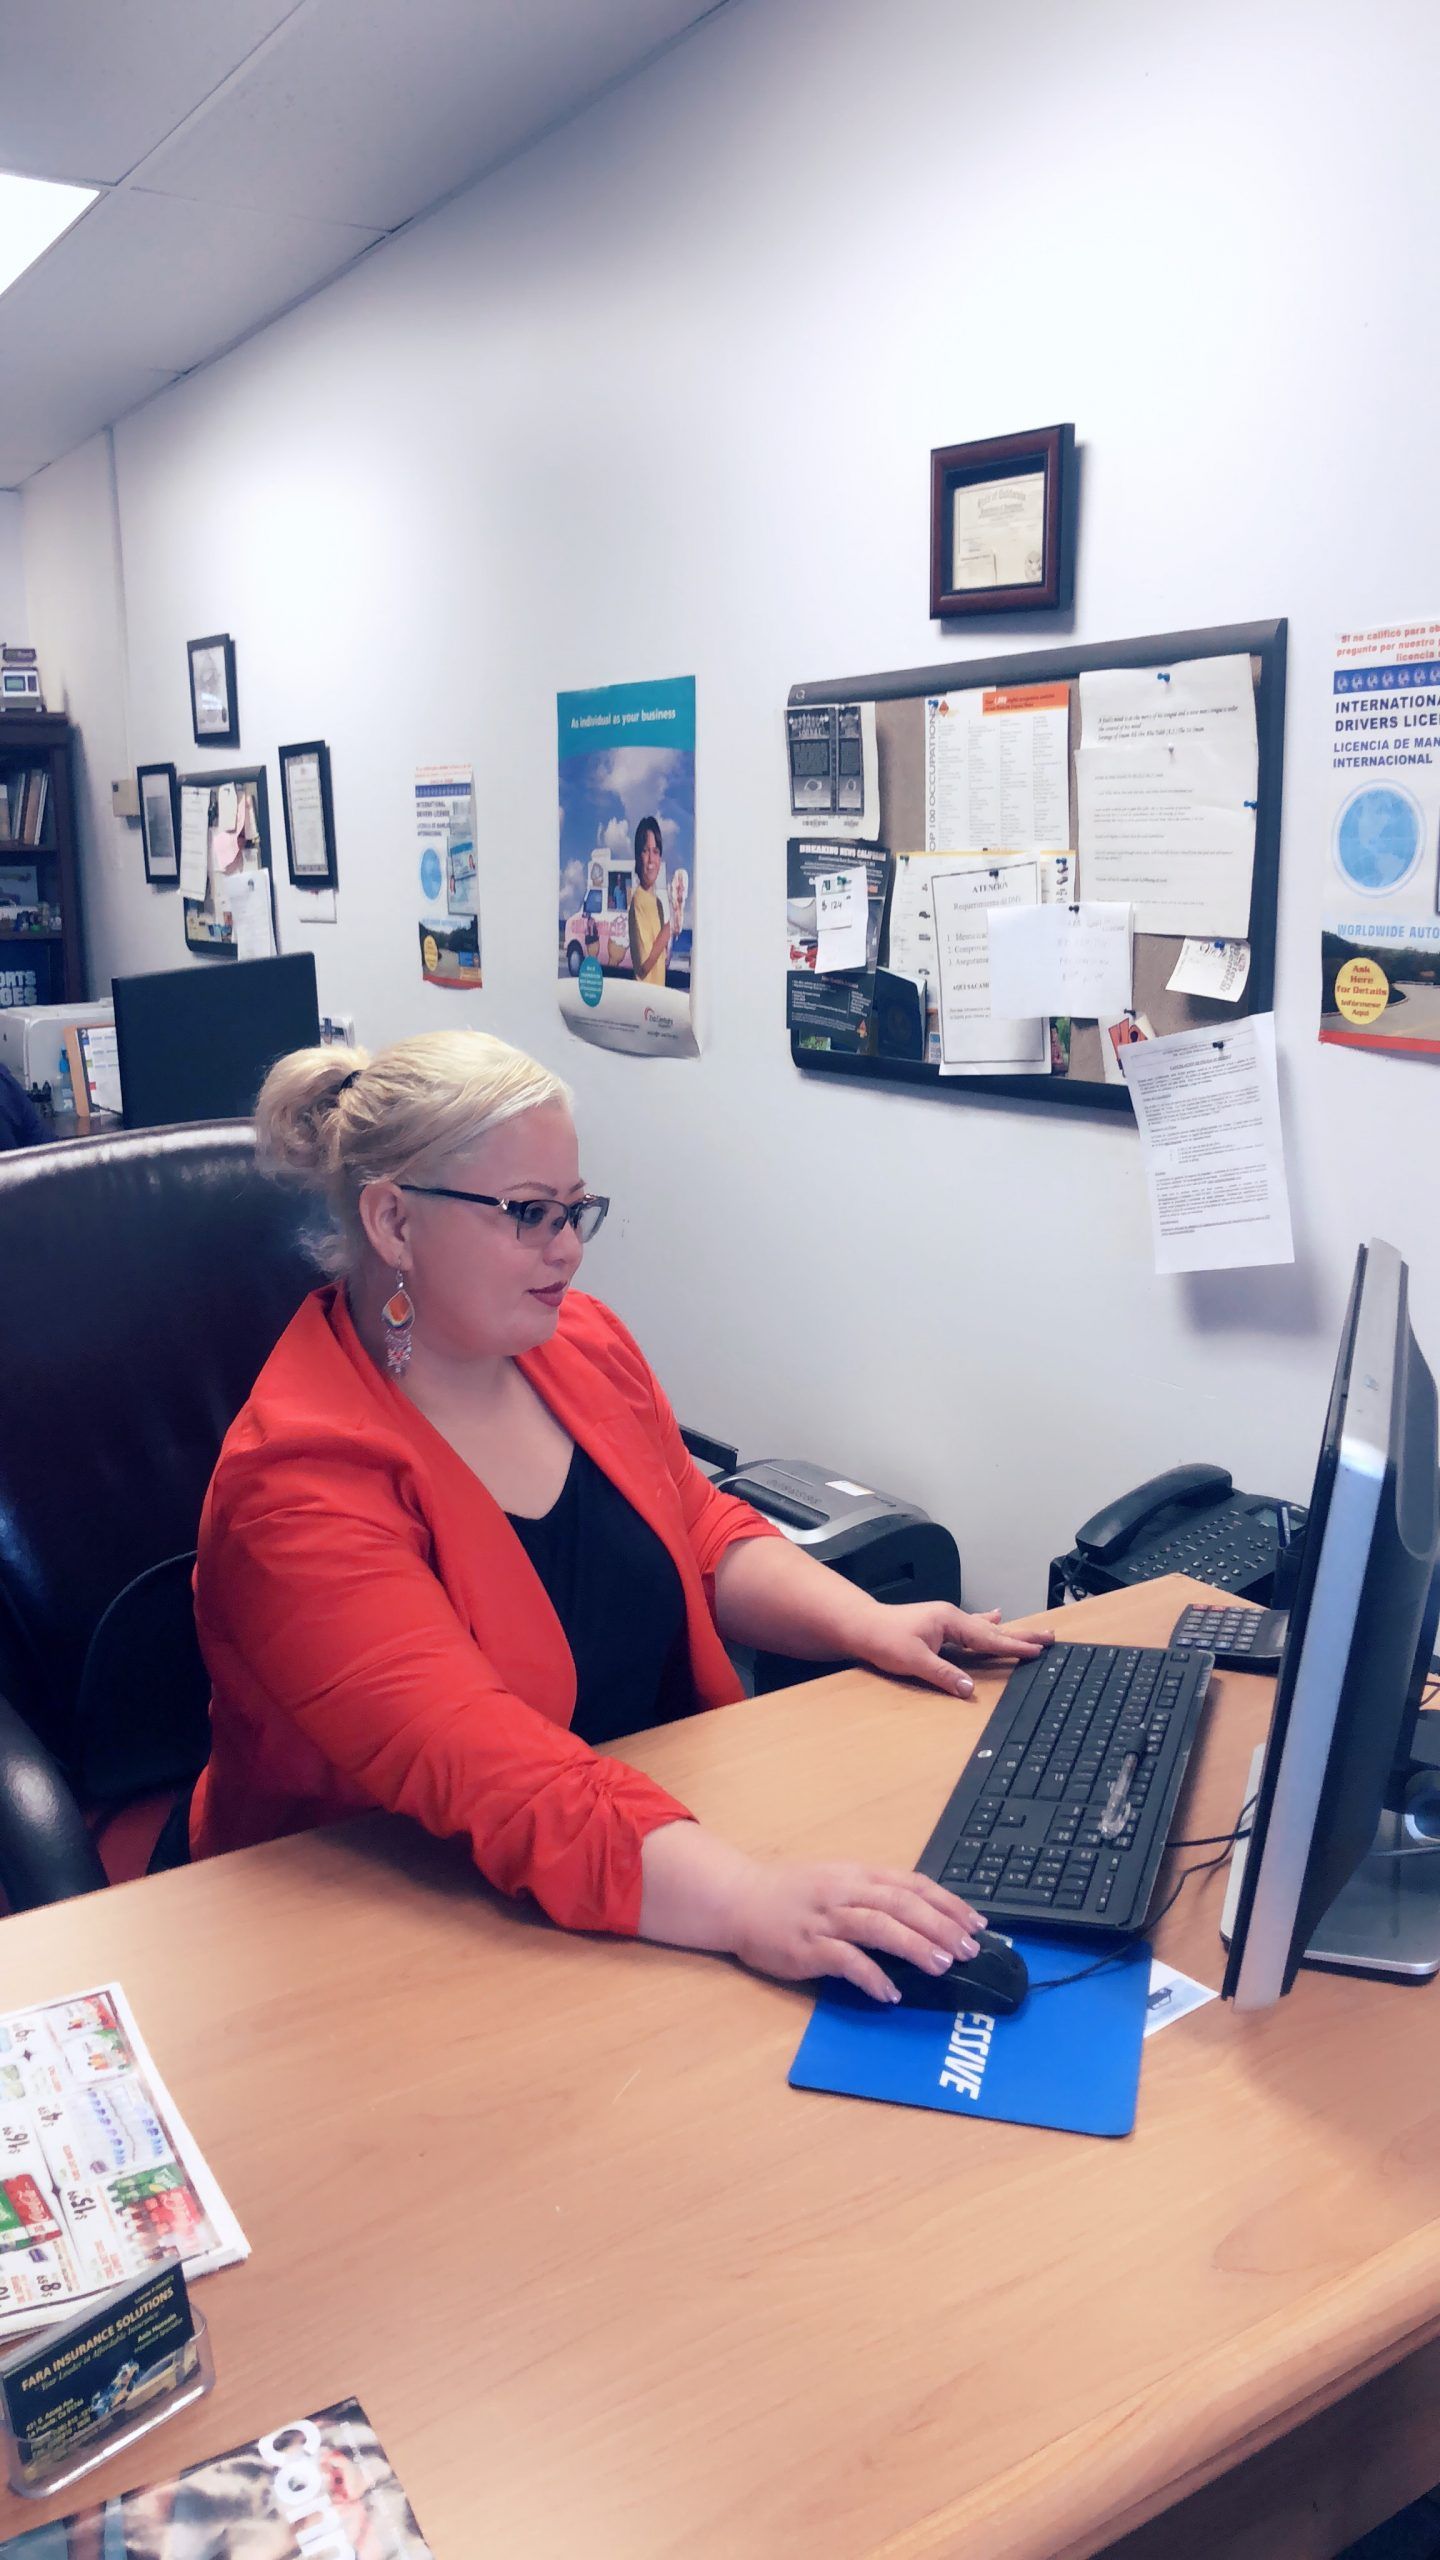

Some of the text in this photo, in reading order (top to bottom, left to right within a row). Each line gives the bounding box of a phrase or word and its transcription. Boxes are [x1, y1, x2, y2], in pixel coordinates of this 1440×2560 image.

[1404, 627, 1426, 638] para
[1380, 643, 1395, 654] por
[1399, 638, 1435, 649] nuestro
[1396, 650, 1435, 662] licencia
[571, 708, 676, 729] As individual as your business
[1335, 713, 1440, 732] DRIVERS LICE
[1334, 739, 1389, 753] LICENCIA
[1393, 738, 1409, 749] DE
[1333, 754, 1432, 768] INTERNACIONAL
[1338, 924, 1405, 938] WORLDWIDE
[21, 2286, 175, 2392] FARA INSURANCE SOLUTIONS
